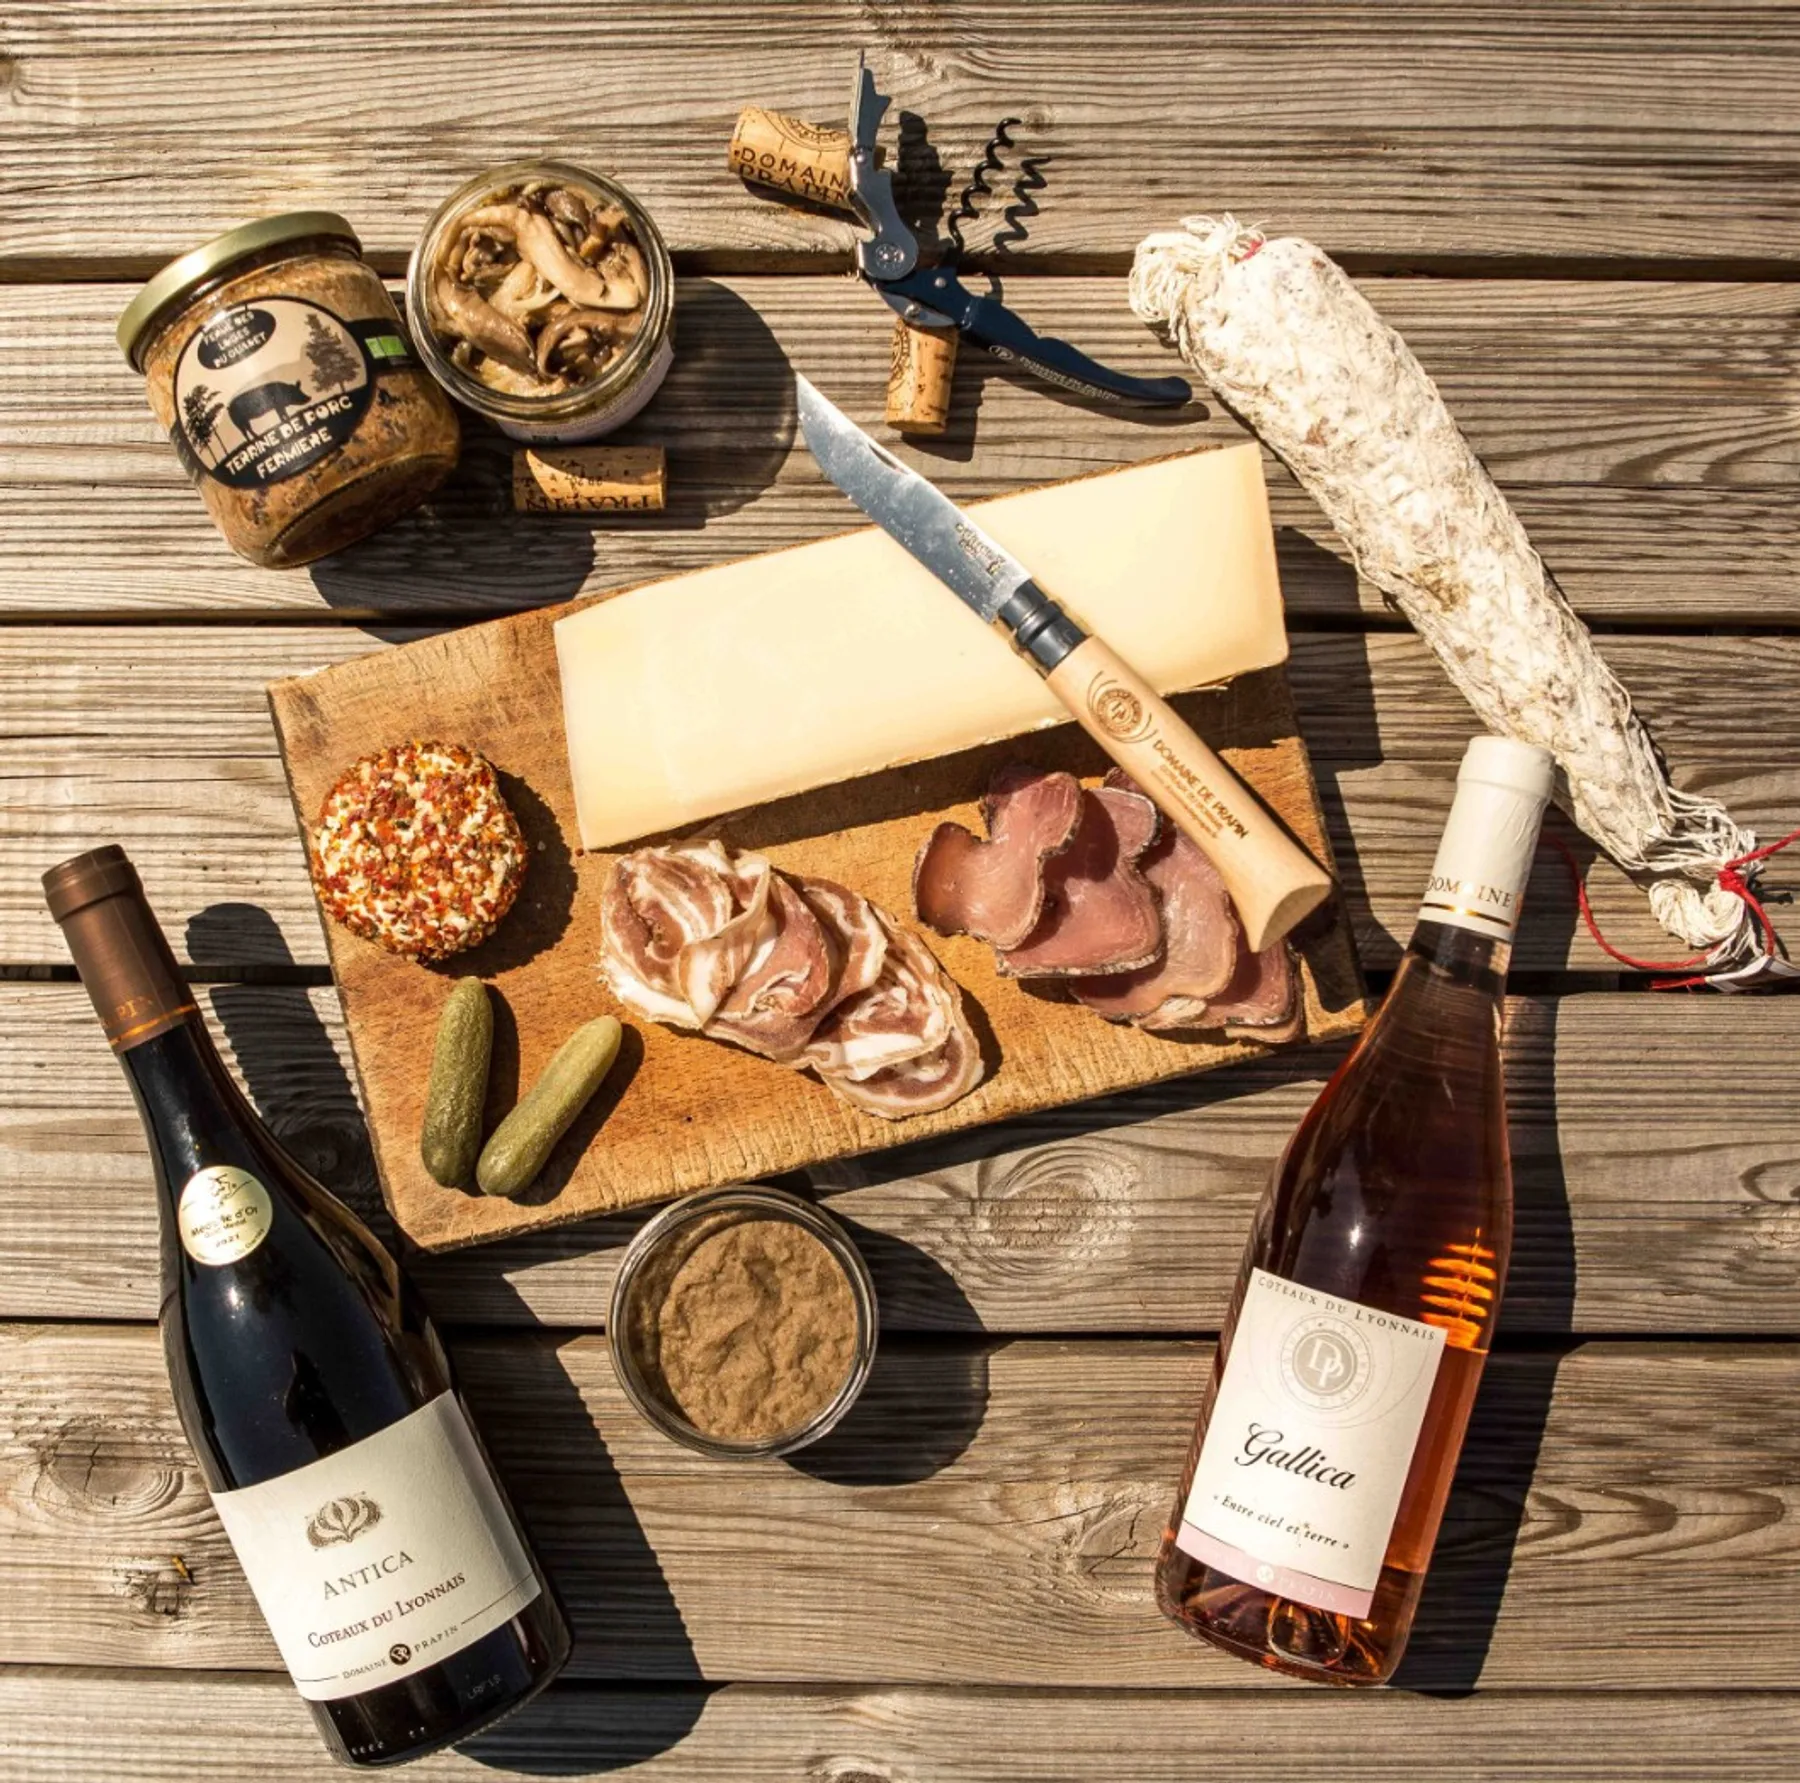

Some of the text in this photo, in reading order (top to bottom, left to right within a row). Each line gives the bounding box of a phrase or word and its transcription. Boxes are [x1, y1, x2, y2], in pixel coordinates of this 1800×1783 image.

[740, 147, 846, 189] DOMAIN
[225, 395, 353, 475] TERRINE DE PORC
[1153, 739, 1201, 787] DOMAINE
[1196, 785, 1215, 802] DE
[1212, 801, 1250, 840] PRAPIN
[1427, 876, 1514, 908] DOMINE
[1257, 1276, 1318, 1306] COTEAUX
[1324, 1300, 1348, 1314] DU
[1234, 1422, 1357, 1490] Gallica
[1221, 1495, 1254, 1517] Entre
[1257, 1512, 1285, 1530] ciel
[1286, 1523, 1300, 1536] et
[1303, 1527, 1339, 1548] terre
[322, 1550, 415, 1601] ANTICA
[342, 1625, 459, 1680] DOMAINE PRAPIN
